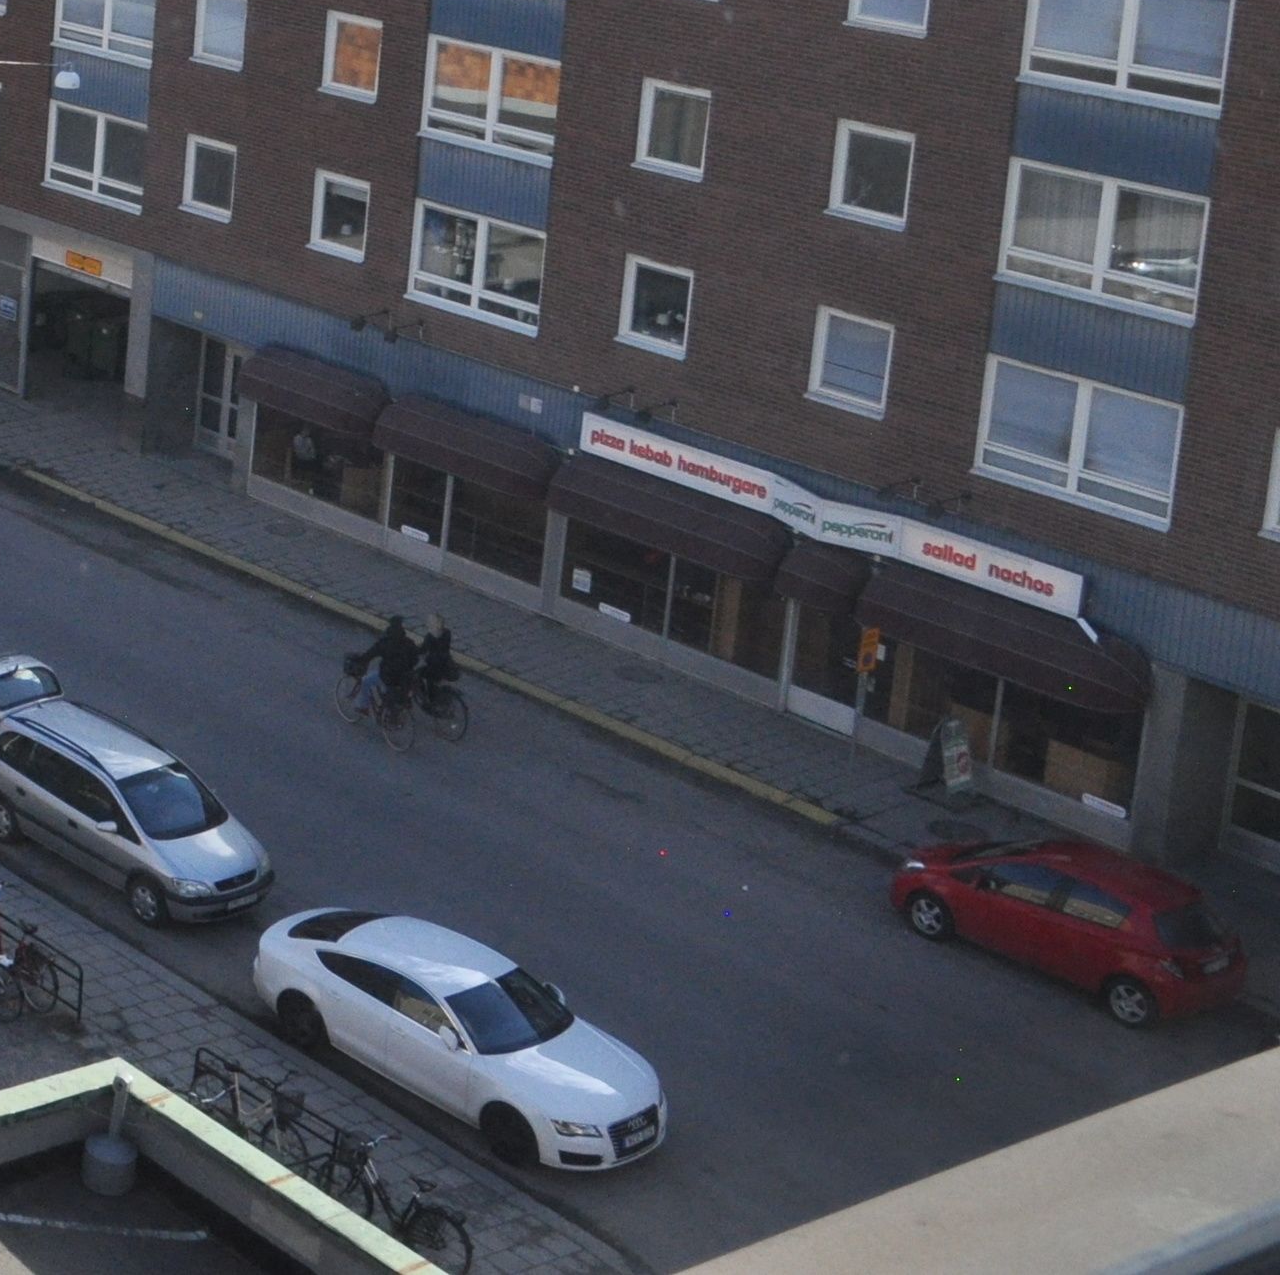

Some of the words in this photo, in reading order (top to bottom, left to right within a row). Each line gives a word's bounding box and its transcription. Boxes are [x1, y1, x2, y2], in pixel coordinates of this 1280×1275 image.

[590, 428, 625, 451] pizza
[629, 439, 673, 468] kebab
[677, 455, 767, 499] hamburgare
[922, 541, 977, 571] sallad
[987, 563, 1056, 597] nachos
